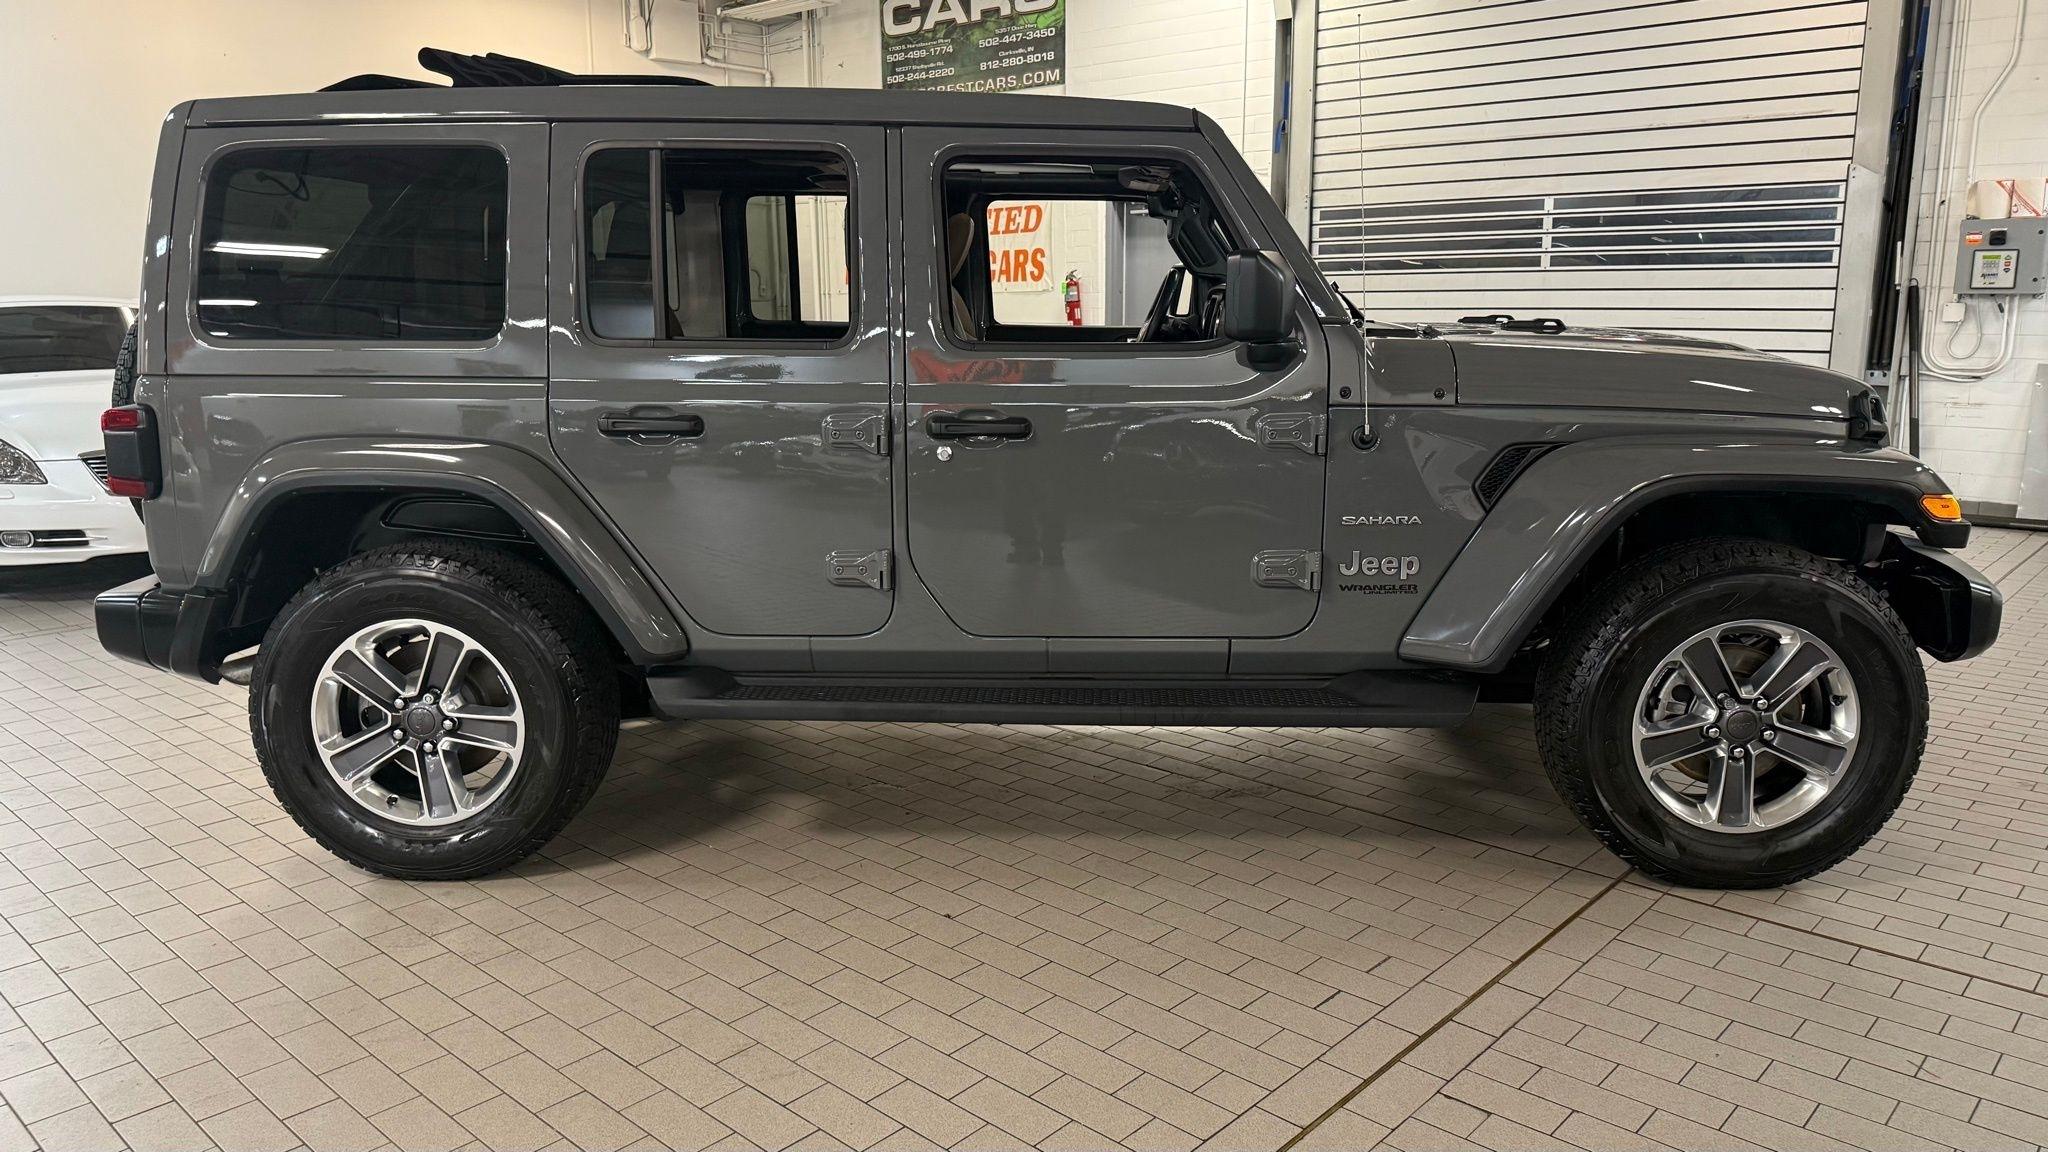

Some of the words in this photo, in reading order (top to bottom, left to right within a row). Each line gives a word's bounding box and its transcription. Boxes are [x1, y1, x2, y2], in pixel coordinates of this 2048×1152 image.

[979, 27, 1056, 48] 502-447-3450
[886, 45, 953, 63] 502-499-1774
[980, 51, 1055, 71] 812-280-8018
[887, 67, 955, 84] 502-244-2220
[1341, 515, 1423, 525] SAHARA
[1339, 550, 1420, 580] Jeep
[1339, 584, 1418, 592] WRANGLER
